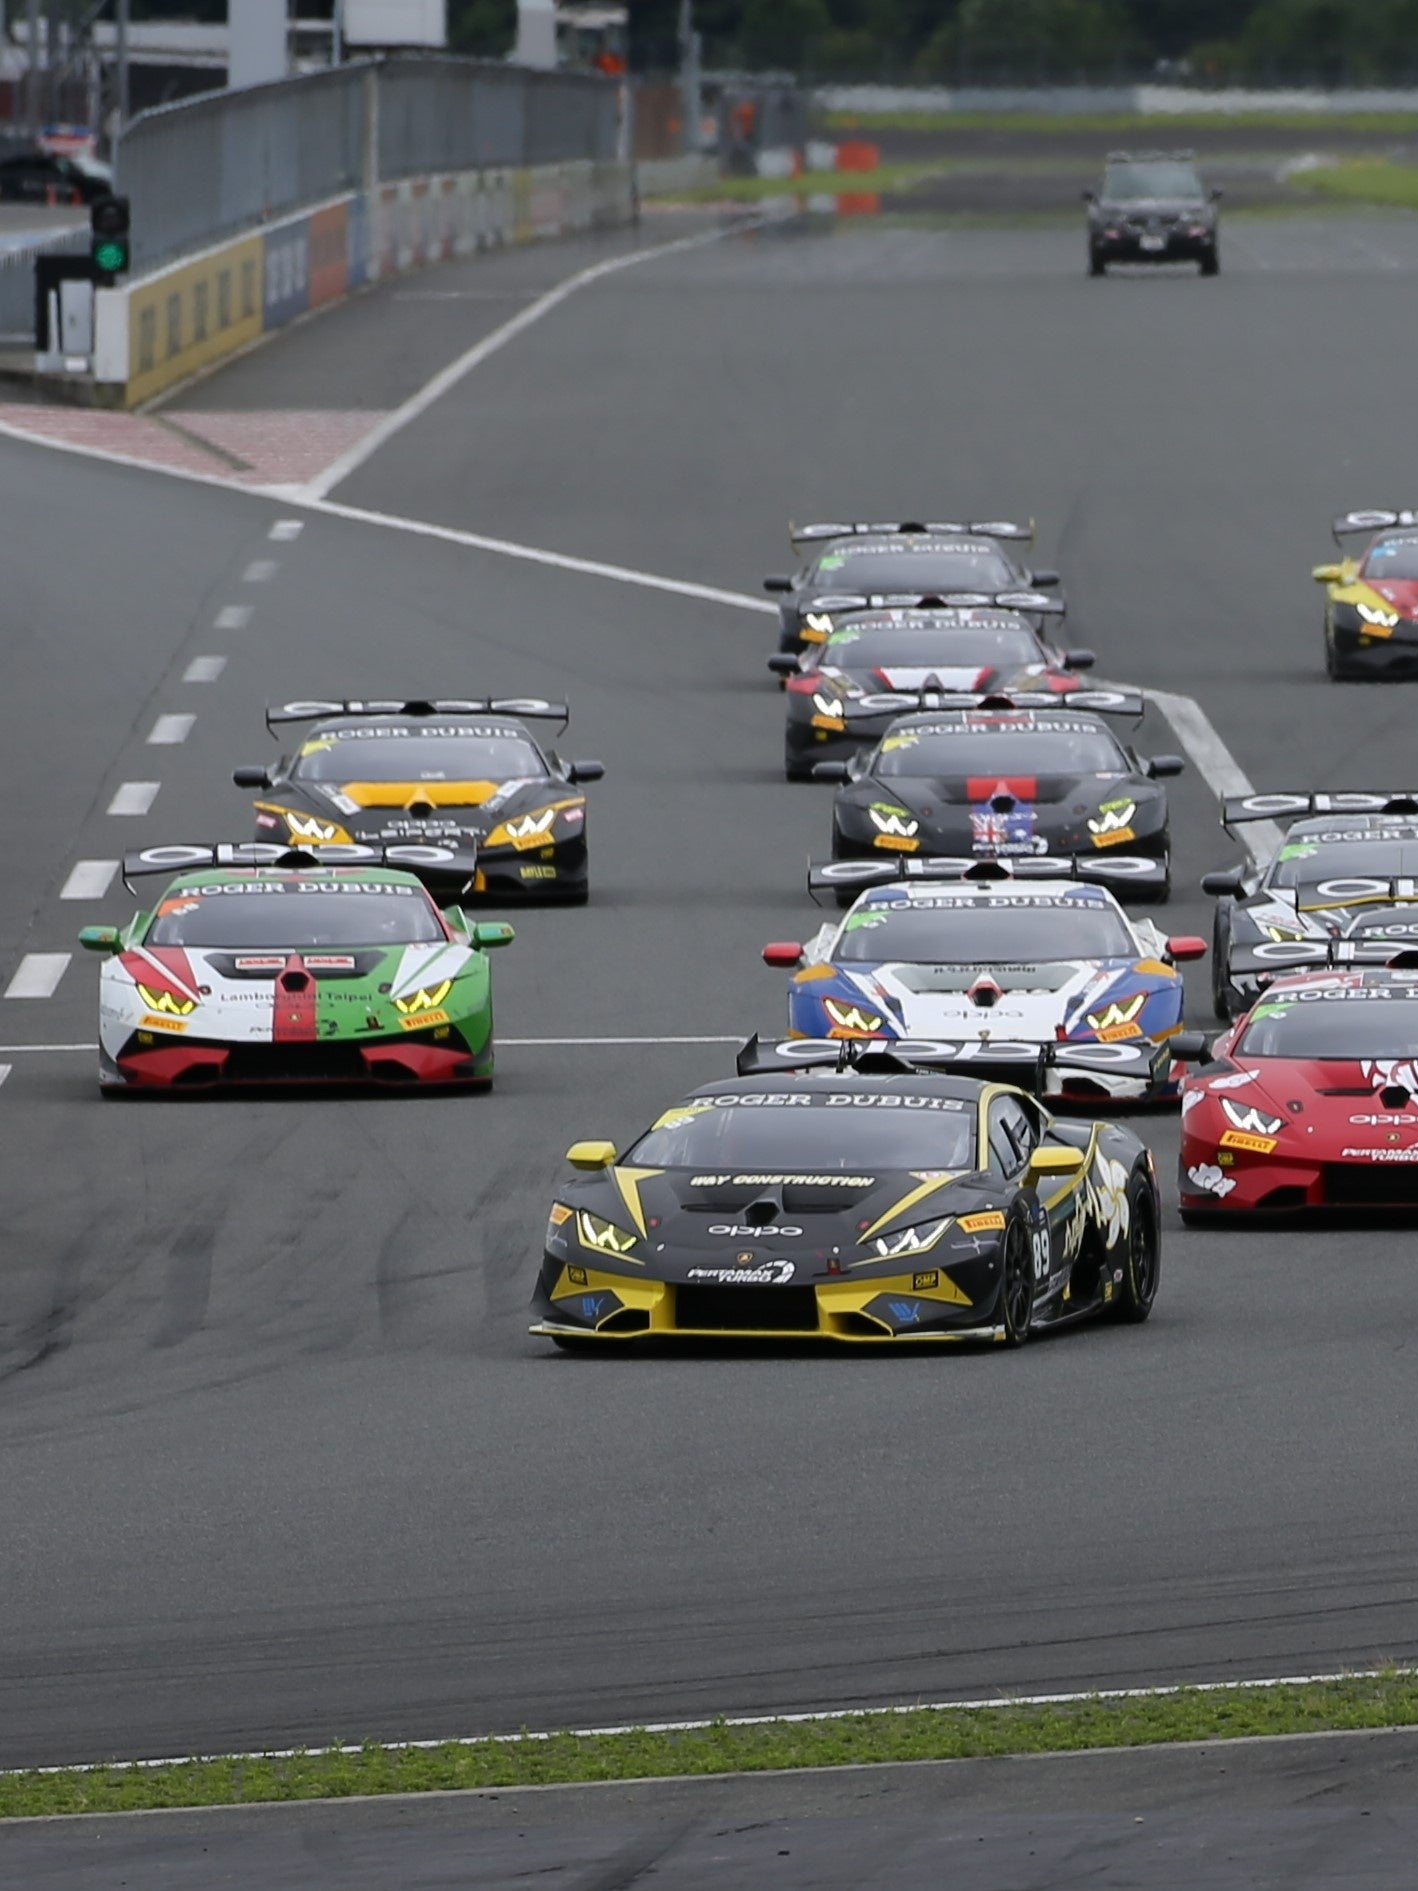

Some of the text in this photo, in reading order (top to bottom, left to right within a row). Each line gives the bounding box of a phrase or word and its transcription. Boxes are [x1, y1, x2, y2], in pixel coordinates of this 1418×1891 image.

[321, 727, 517, 740] ROGER DUBUIS
[1302, 830, 1401, 842] ROGER
[179, 881, 414, 896] ROGER DUBUIS
[869, 897, 1105, 911] ROGER DUBUIS
[327, 992, 373, 1004] Taipei
[1275, 989, 1391, 1003] ROGER
[689, 1094, 964, 1110] ROGER DUBUIS
[733, 1174, 875, 1187] CONSTRUCTION
[1033, 1228, 1050, 1280] 89
